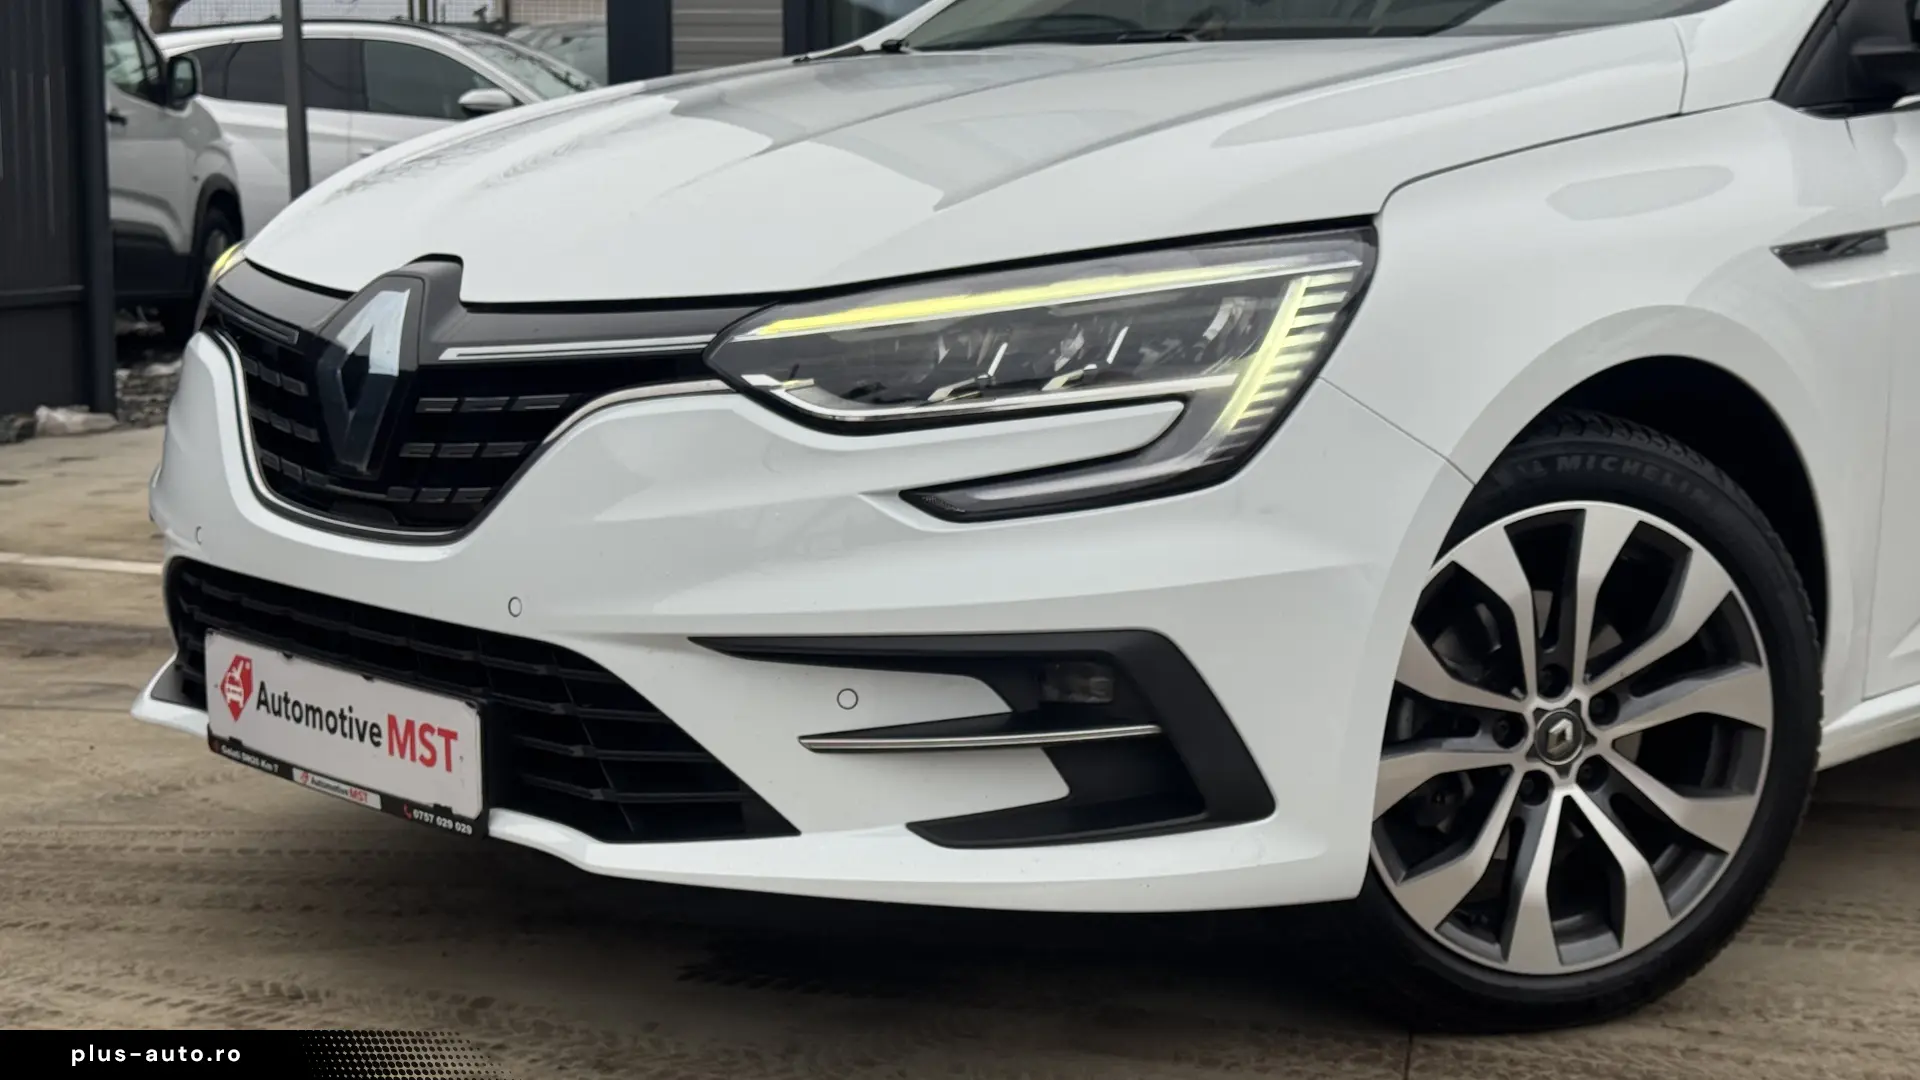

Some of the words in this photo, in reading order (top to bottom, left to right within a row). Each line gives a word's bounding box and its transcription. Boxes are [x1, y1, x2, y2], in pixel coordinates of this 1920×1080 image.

[1556, 454, 1712, 502] MICHELIN
[256, 680, 383, 748] Automotive
[387, 713, 459, 773] MST
[412, 808, 435, 824] 0757
[435, 815, 454, 830] 029
[454, 821, 473, 836] 029
